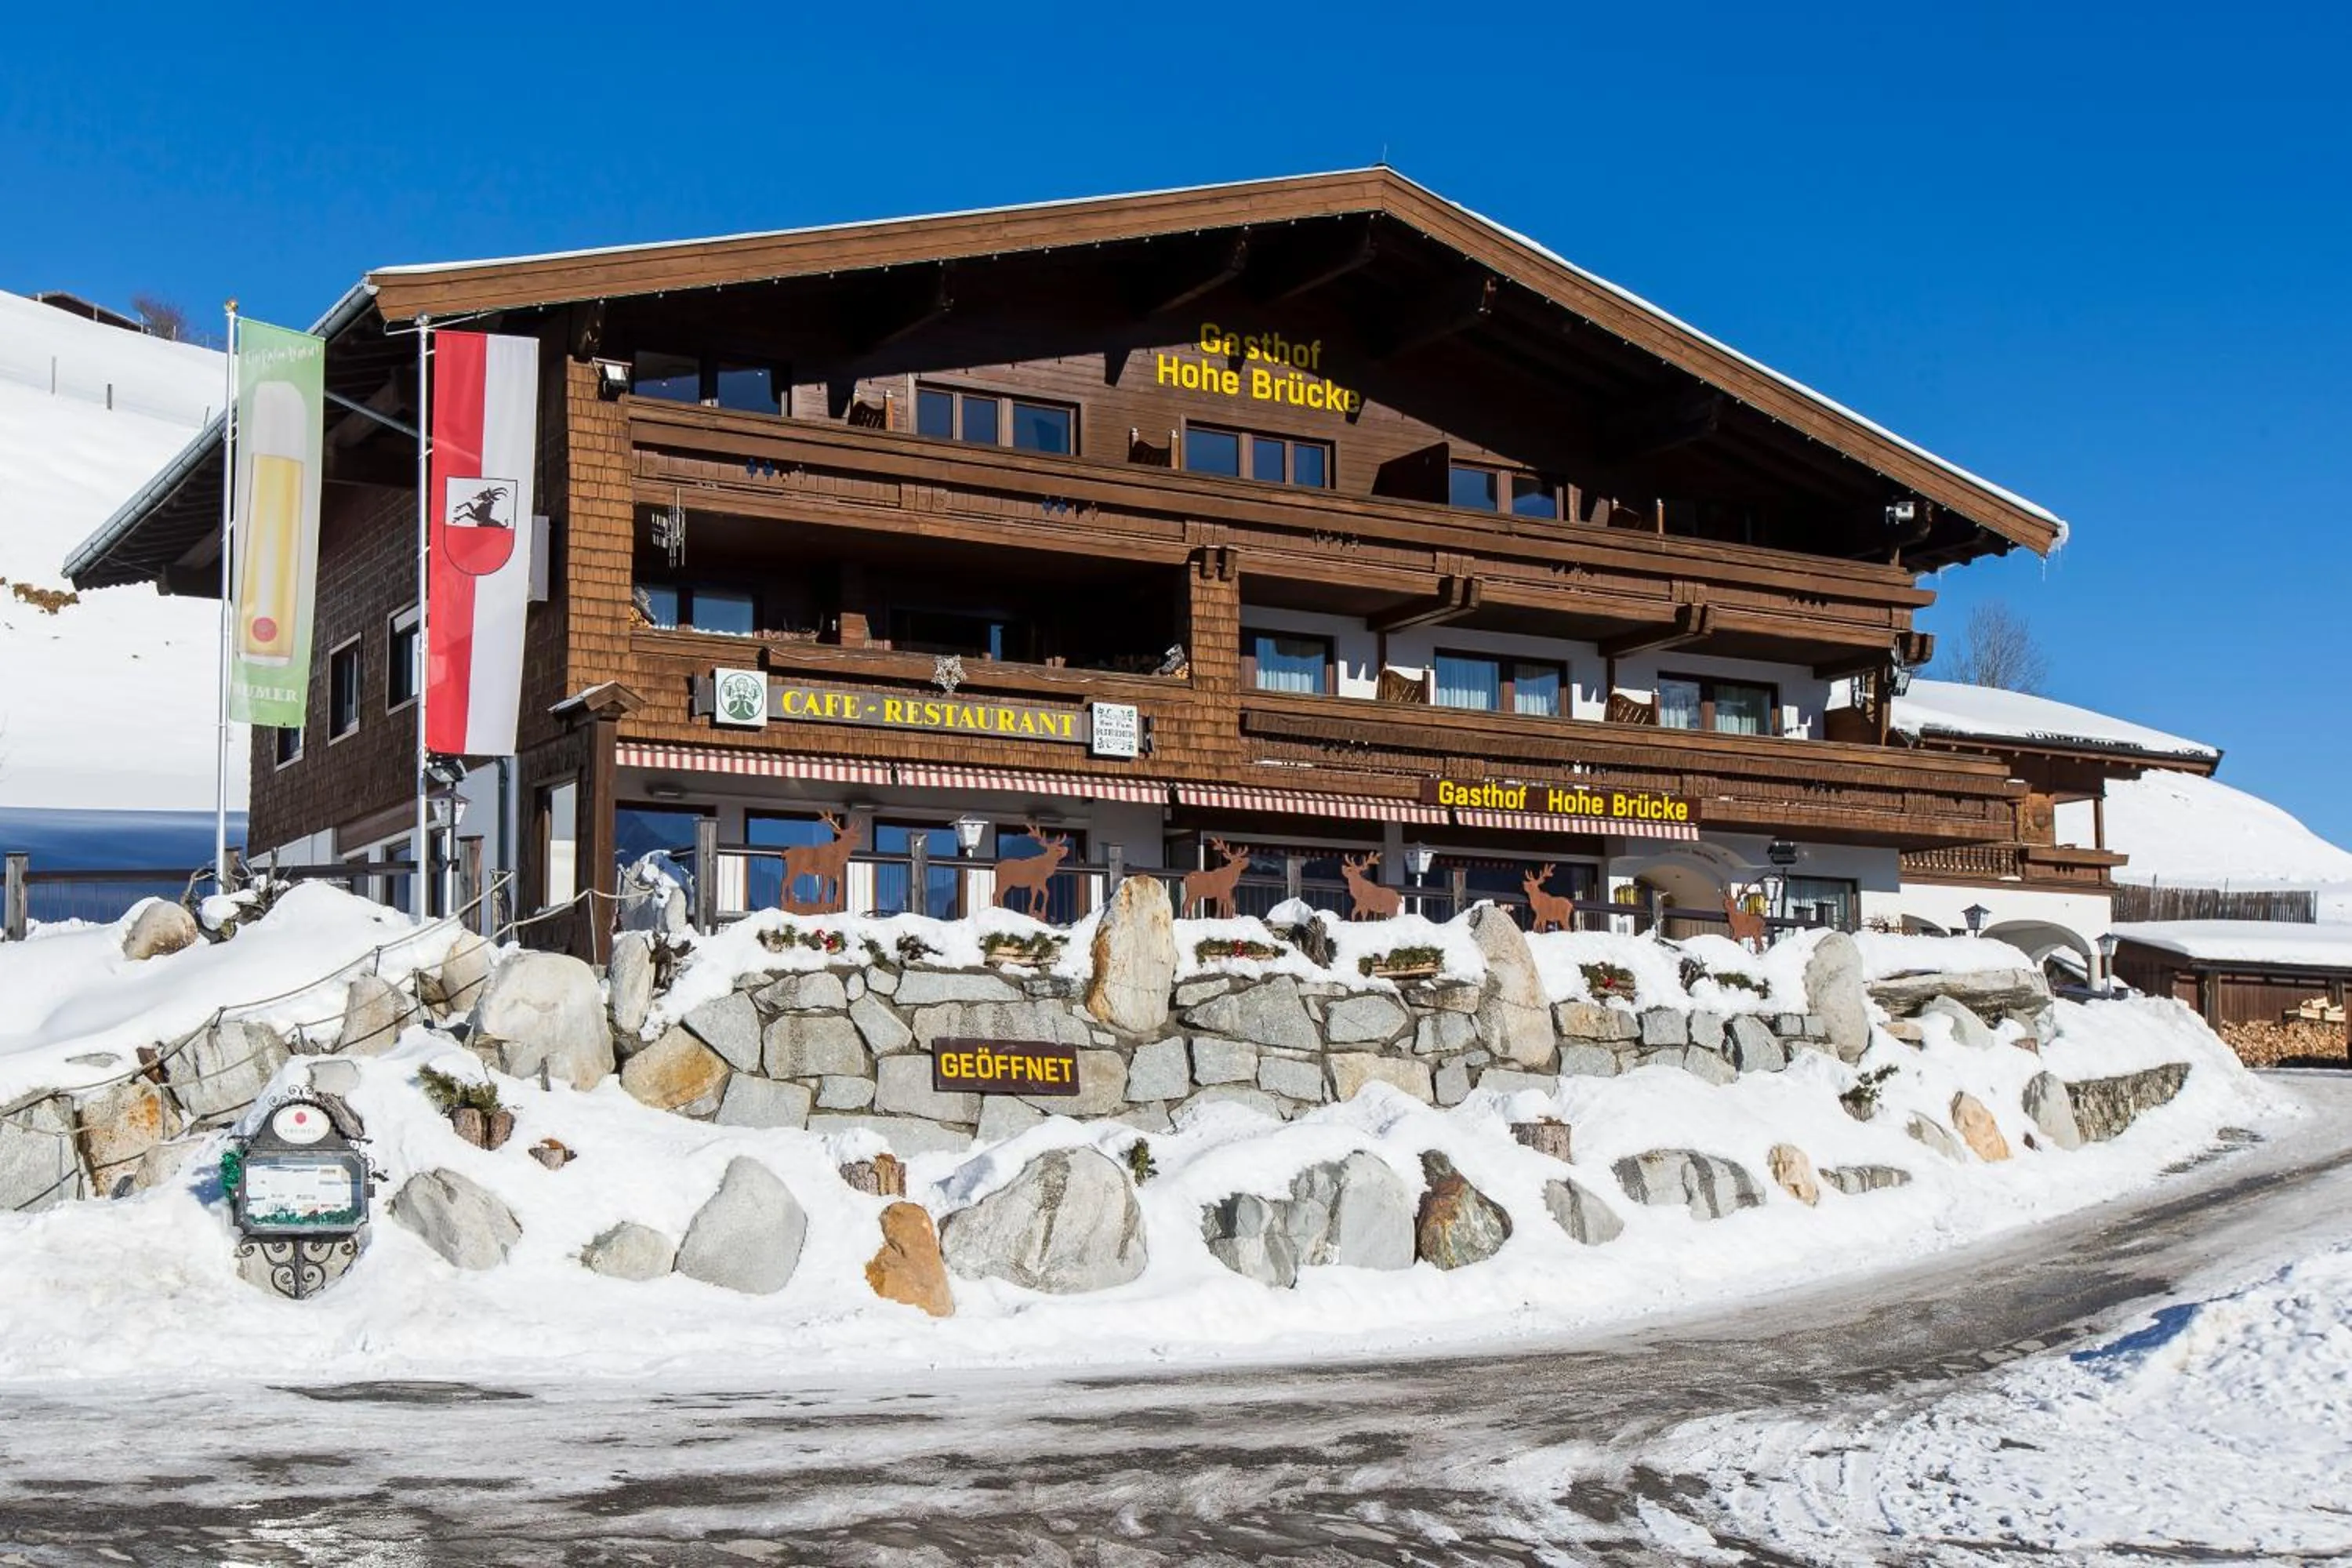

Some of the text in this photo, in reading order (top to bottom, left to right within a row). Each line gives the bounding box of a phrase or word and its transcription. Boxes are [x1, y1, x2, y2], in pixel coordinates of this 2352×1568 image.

[1200, 322, 1321, 369] Gasthof
[1156, 354, 1361, 413] Hohe Brücke
[782, 689, 862, 720] CAFE
[883, 699, 1076, 737] RESTAURANT
[1439, 780, 1688, 821] Gasthof Hohe Brücke
[941, 1047, 1073, 1083] GEÖFFNET
